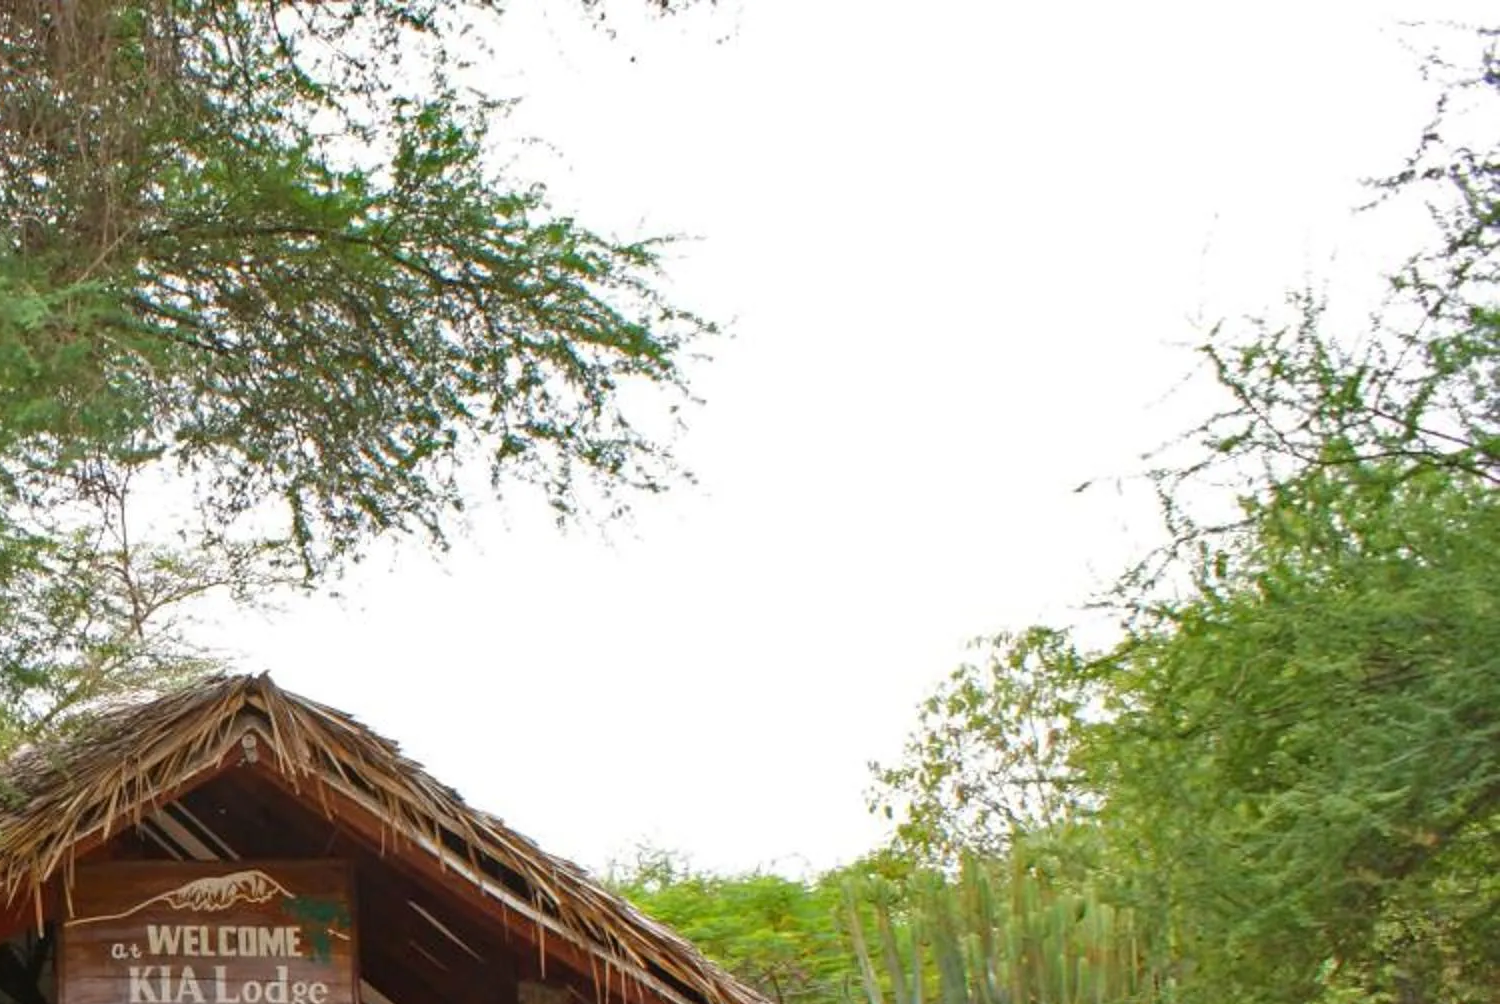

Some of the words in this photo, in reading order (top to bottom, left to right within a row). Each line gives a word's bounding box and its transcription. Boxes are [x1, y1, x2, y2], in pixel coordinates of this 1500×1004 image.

[111, 942, 142, 959] at
[147, 924, 303, 957] WELCOME
[128, 965, 207, 1004] KIA
